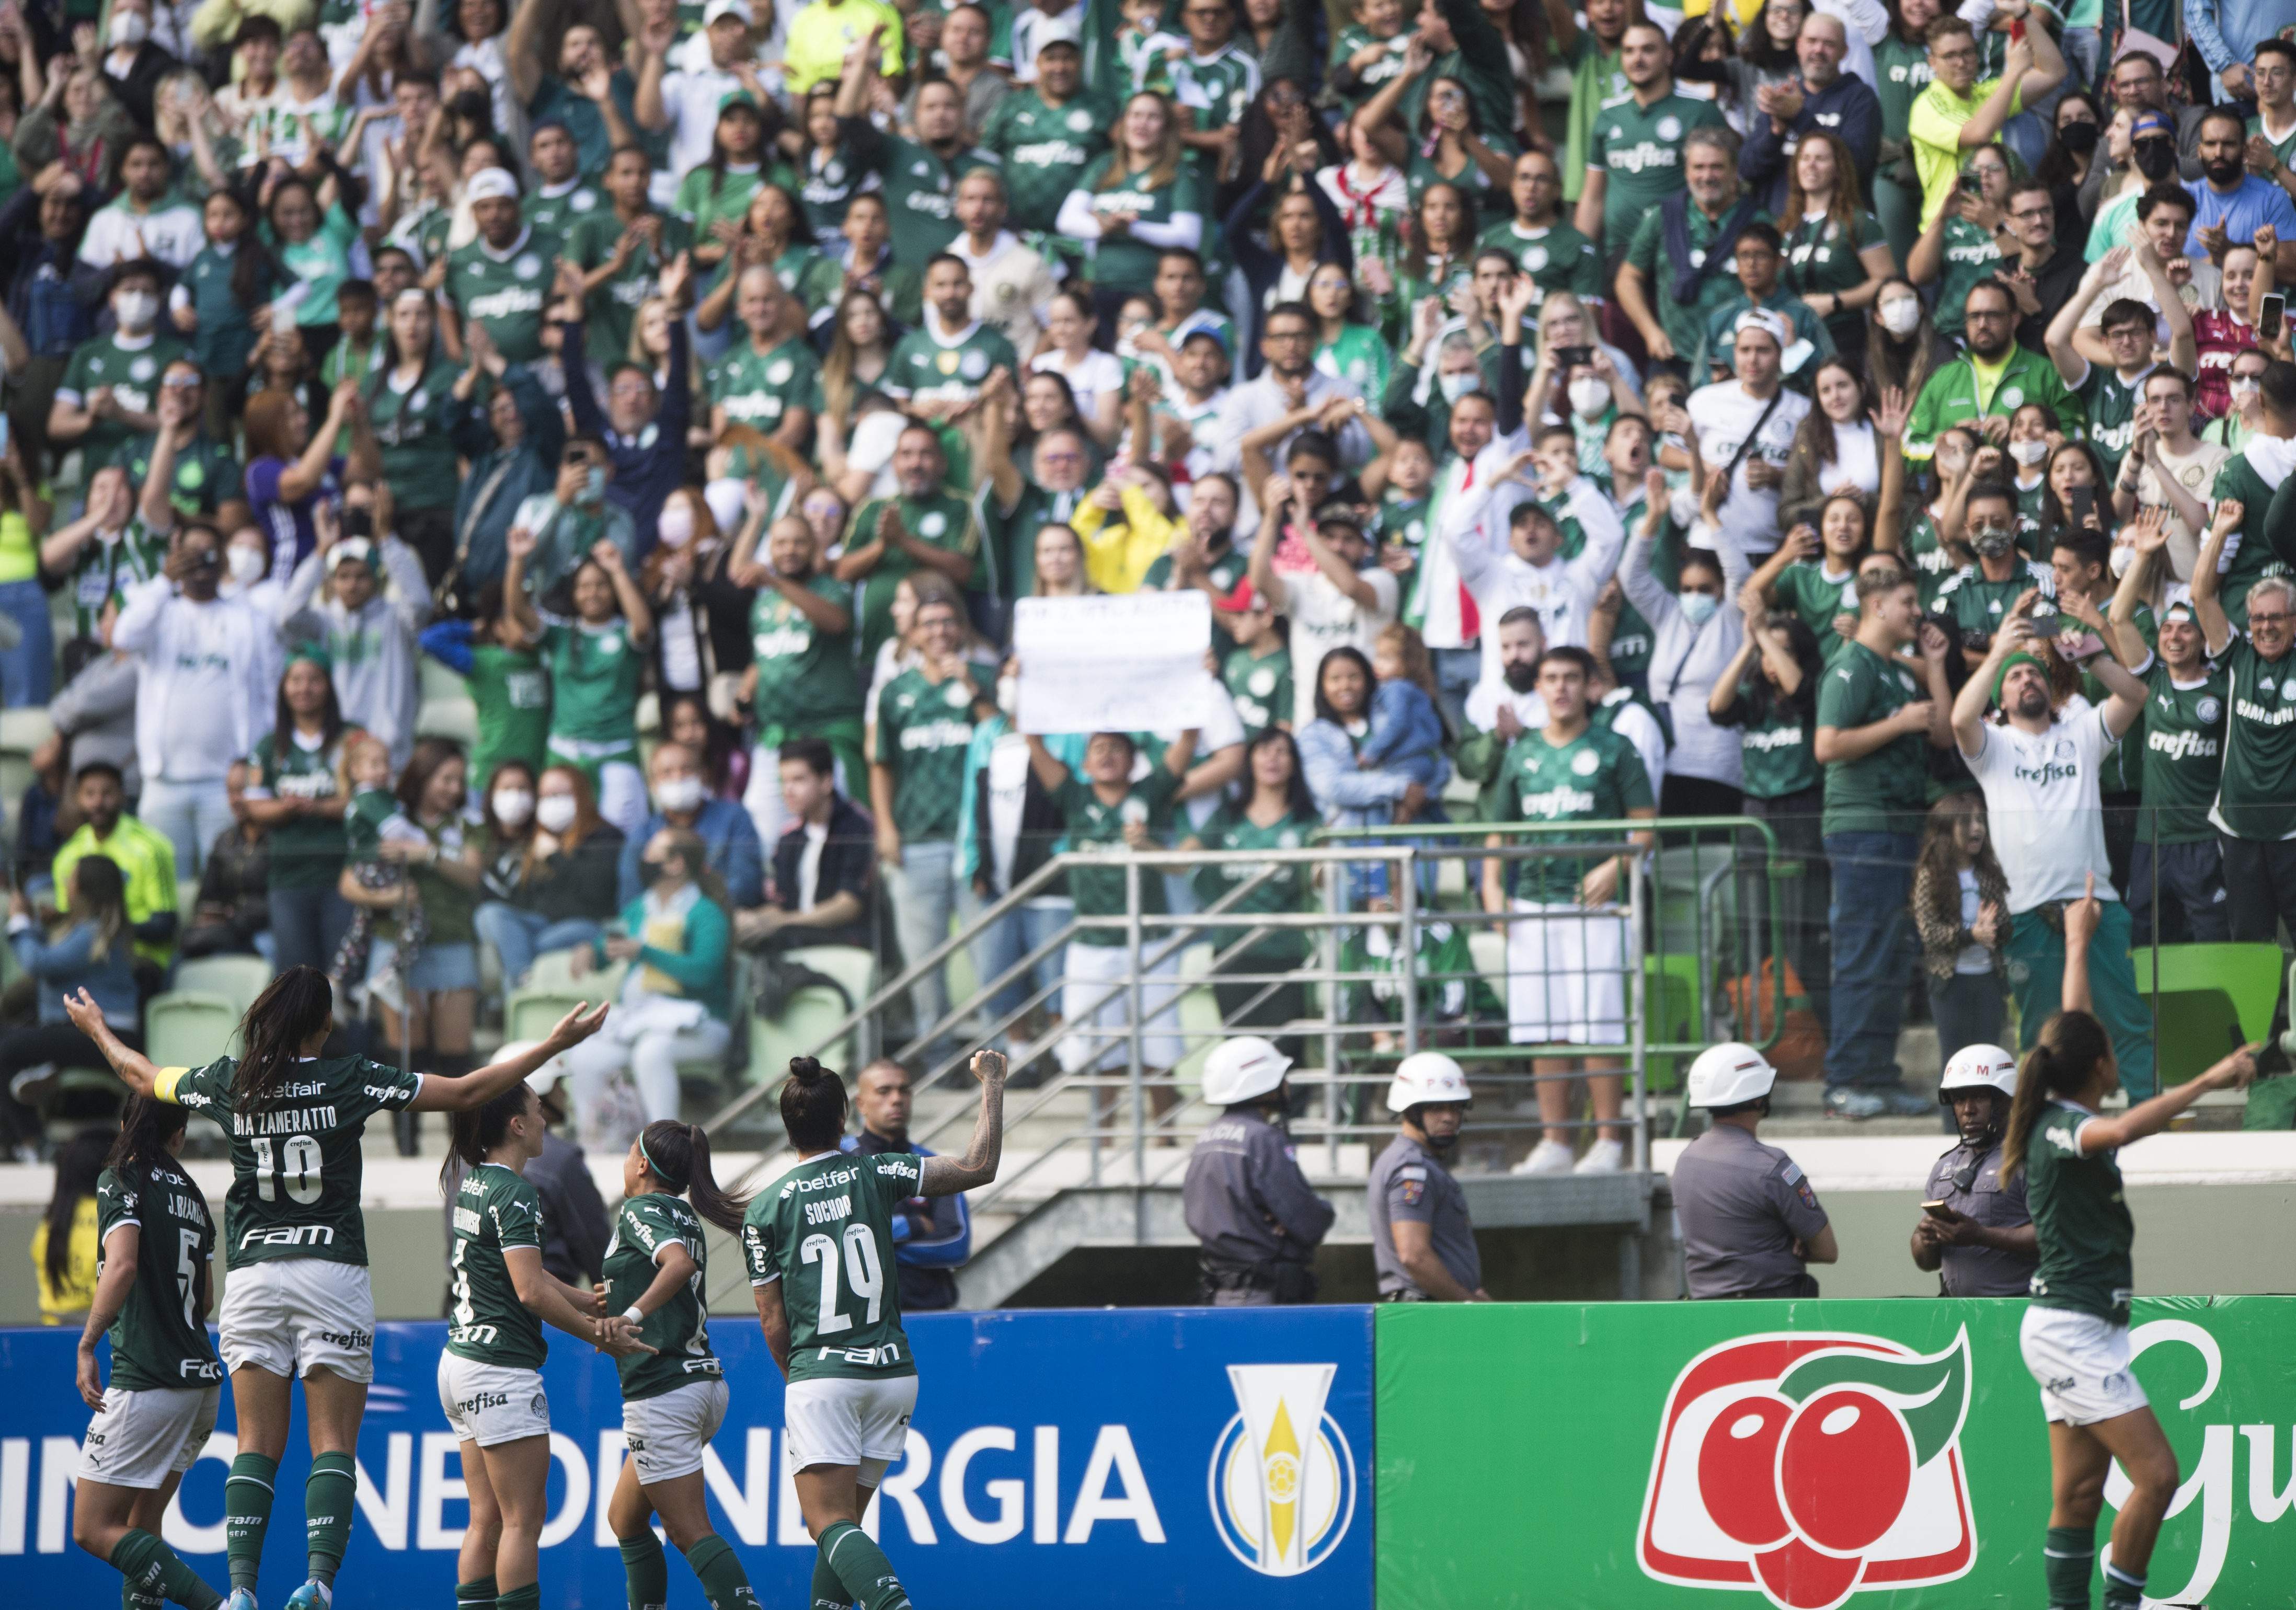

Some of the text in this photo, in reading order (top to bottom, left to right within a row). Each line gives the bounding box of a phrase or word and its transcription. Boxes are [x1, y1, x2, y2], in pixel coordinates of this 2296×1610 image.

[1607, 142, 1676, 174] crefisa
[2236, 698, 2296, 726] SAMSUN
[2149, 730, 2217, 761] crefisa
[2015, 762, 2077, 787] crefisa
[1977, 1065, 1989, 1076] M
[364, 1084, 411, 1103] crefisa
[234, 1106, 337, 1135] BIA ZANERATTO
[251, 1135, 323, 1204] 10
[797, 1166, 859, 1193] betfair
[877, 1161, 917, 1180] crefisa
[805, 1195, 852, 1225] SOCHOR
[626, 1211, 656, 1250] crefisa
[806, 1237, 827, 1248] crefisa
[846, 1227, 866, 1237] crefisa
[177, 1227, 201, 1330] 5
[800, 1223, 883, 1335] 29
